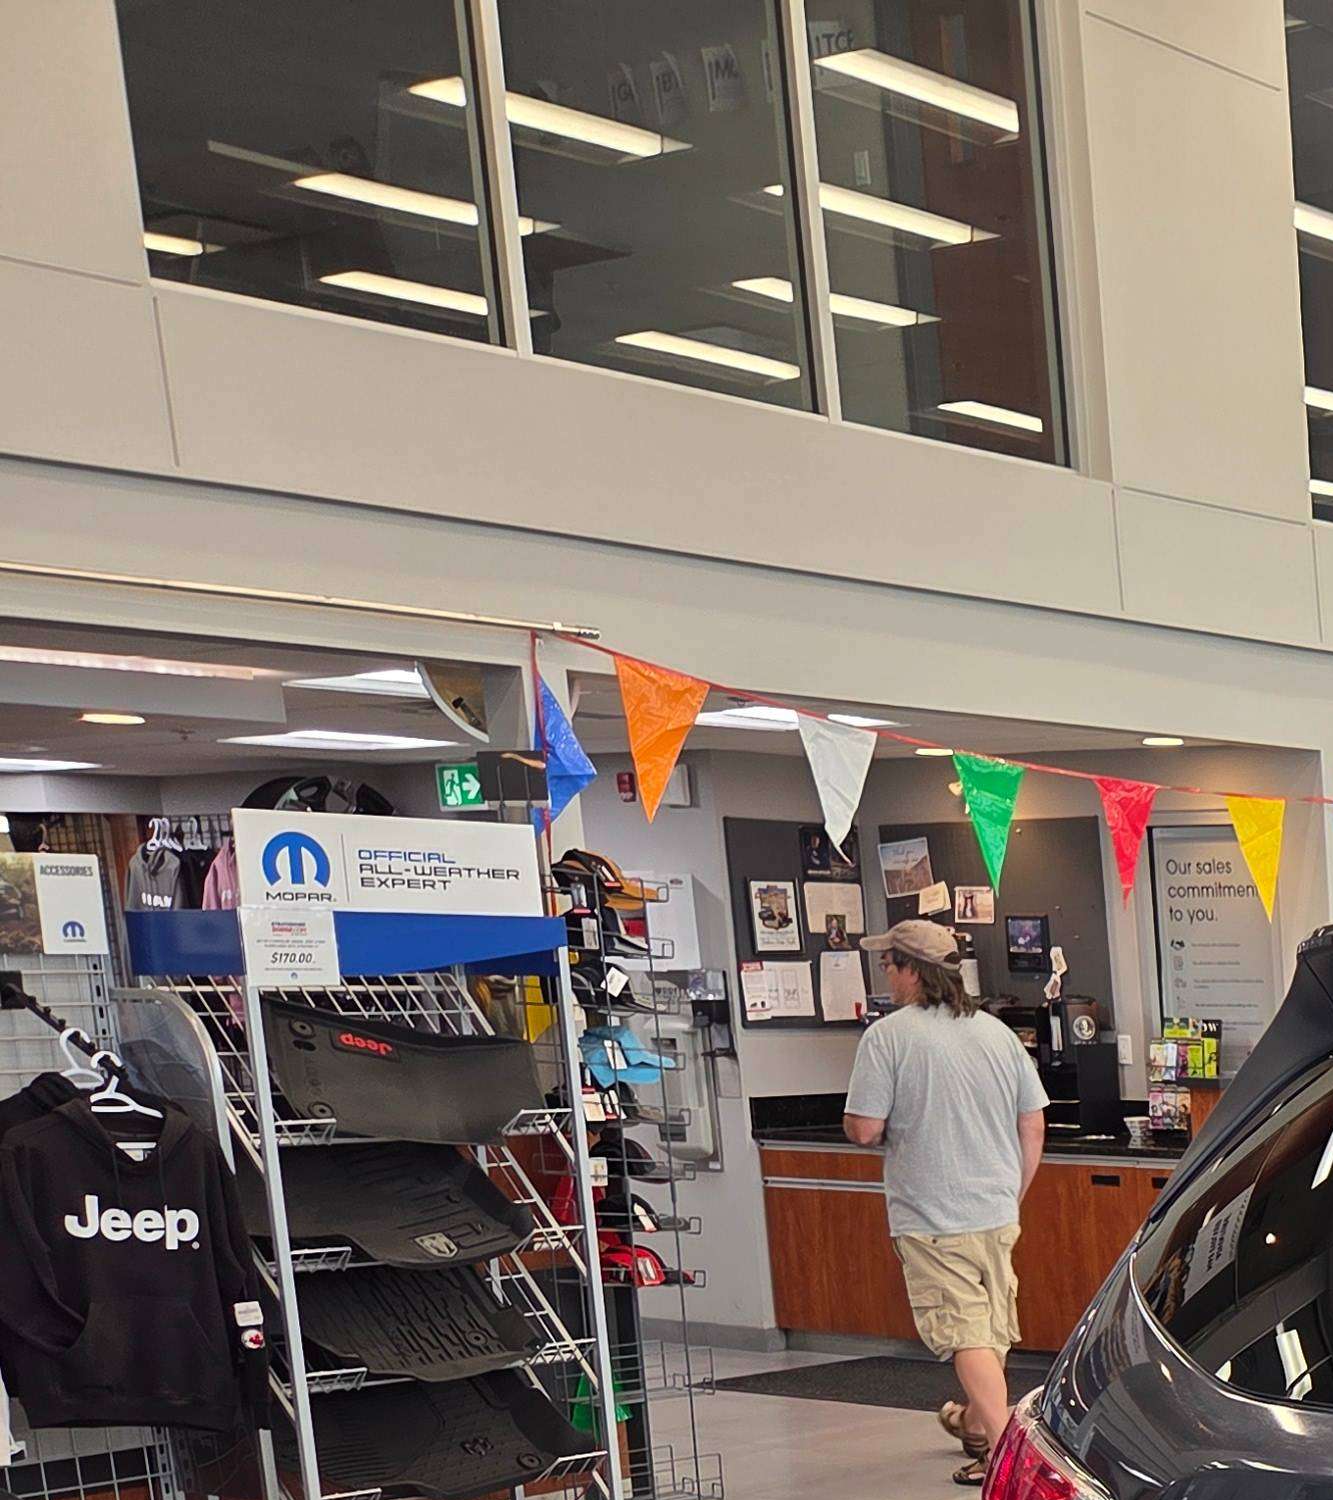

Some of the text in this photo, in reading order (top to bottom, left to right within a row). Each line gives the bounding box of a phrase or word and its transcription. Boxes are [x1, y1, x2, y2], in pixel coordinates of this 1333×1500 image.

[358, 849, 456, 864] OFFICIAL
[359, 863, 520, 880] ALL-WEATHER
[1166, 858, 1232, 875] Our sales
[360, 876, 451, 891] EXPERT
[266, 891, 336, 902] MOPAR
[1169, 906, 1218, 925] to you.
[271, 952, 312, 964] $170.00
[340, 1033, 393, 1055] Jeep
[64, 1194, 200, 1250] Jeep
